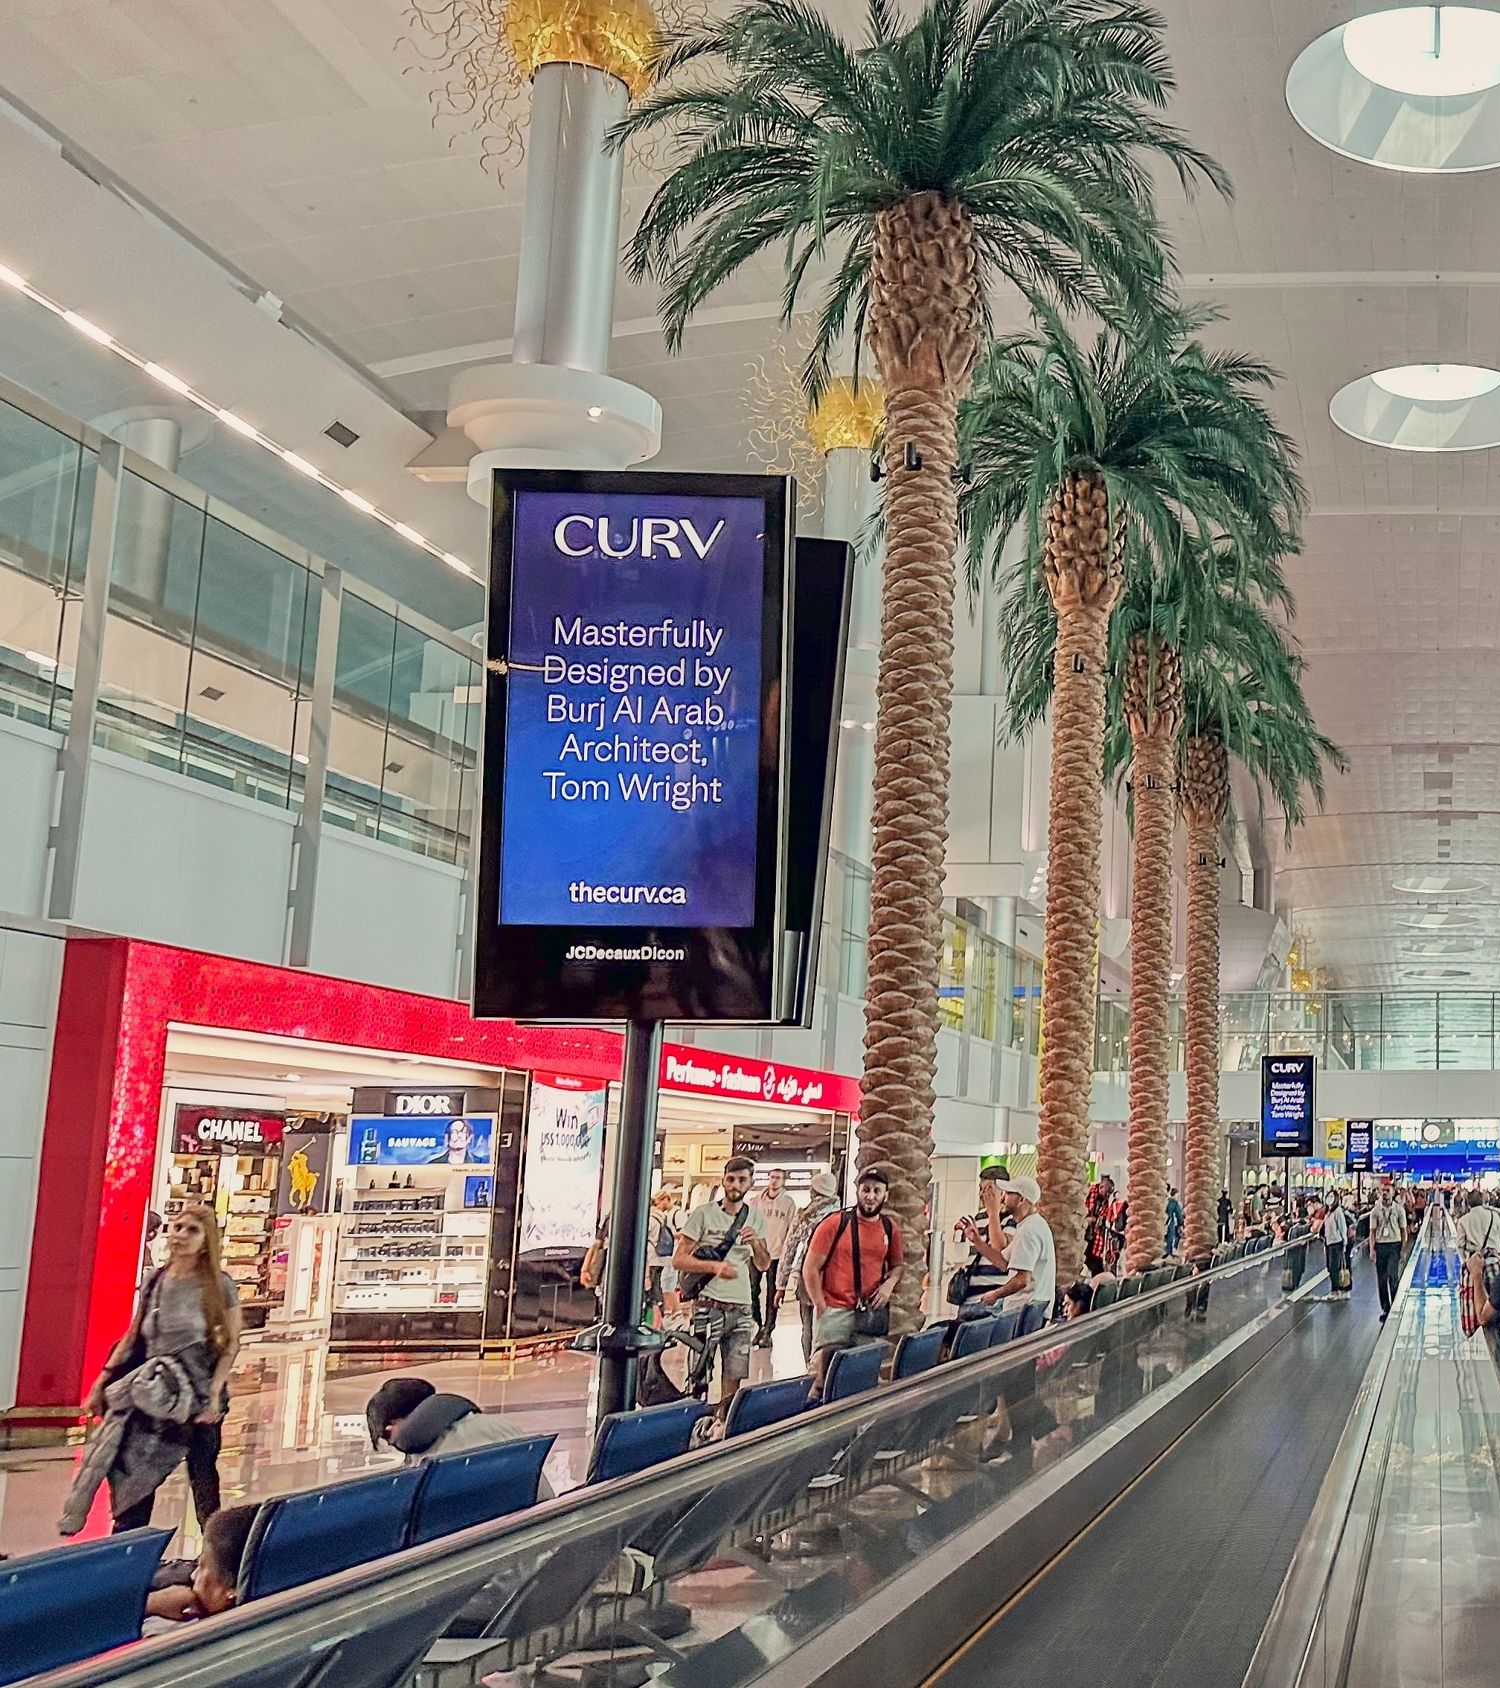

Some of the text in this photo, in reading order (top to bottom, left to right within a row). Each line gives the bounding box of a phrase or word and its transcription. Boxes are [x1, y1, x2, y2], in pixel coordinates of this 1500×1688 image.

[554, 515, 725, 559] CURV
[554, 616, 724, 656] Masterfully
[543, 655, 731, 695] Designed by
[547, 694, 724, 731] Burj Al Arab
[559, 733, 708, 767] Architect,
[542, 771, 723, 810] Tom Wright
[569, 881, 687, 905] thecurv.ca
[565, 945, 685, 960] JCDecauxDicon
[666, 1056, 761, 1093] Perfume Fashion
[1271, 1063, 1304, 1073] CURV
[395, 1095, 451, 1114] DIOR
[555, 1107, 578, 1129] Win
[198, 1118, 264, 1143] CHANEL
[388, 1136, 437, 1148] SAUVAGE
